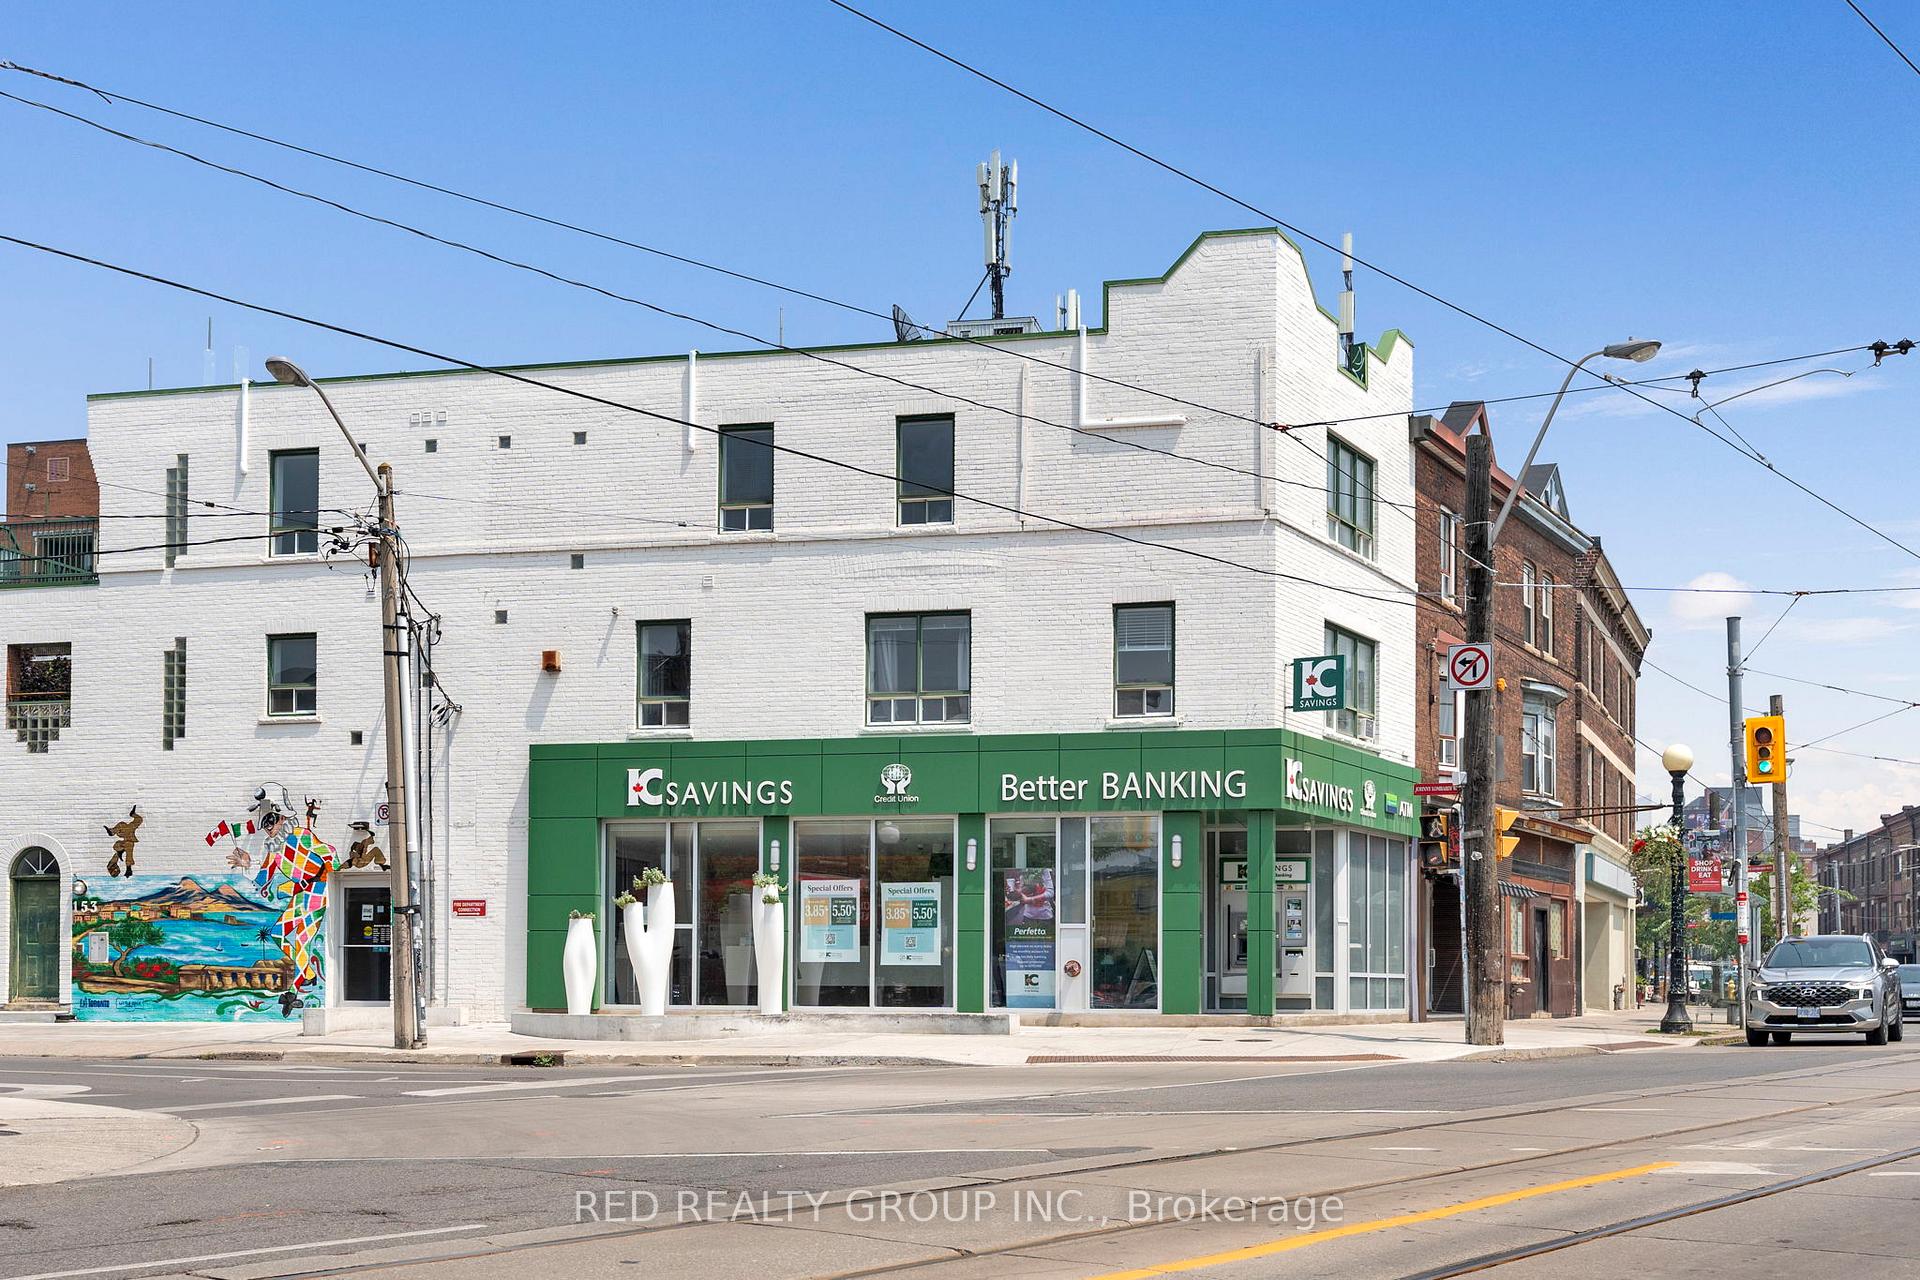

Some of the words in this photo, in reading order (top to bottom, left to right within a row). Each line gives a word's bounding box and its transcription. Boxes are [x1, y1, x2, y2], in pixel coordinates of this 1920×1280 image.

[1300, 698, 1337, 708] SAVINGS
[1001, 774, 1088, 800] Better
[1102, 770, 1247, 799] BANKING
[666, 780, 793, 806] SAVINGS
[1302, 777, 1353, 812] SAVINGS
[874, 795, 896, 803] Credit
[897, 794, 919, 803] Union
[1399, 800, 1413, 818] ATM
[807, 884, 832, 893] Special
[833, 884, 853, 892] Offers
[888, 887, 912, 896] Special
[73, 901, 98, 912] 153
[1014, 927, 1046, 935] Perfetto
